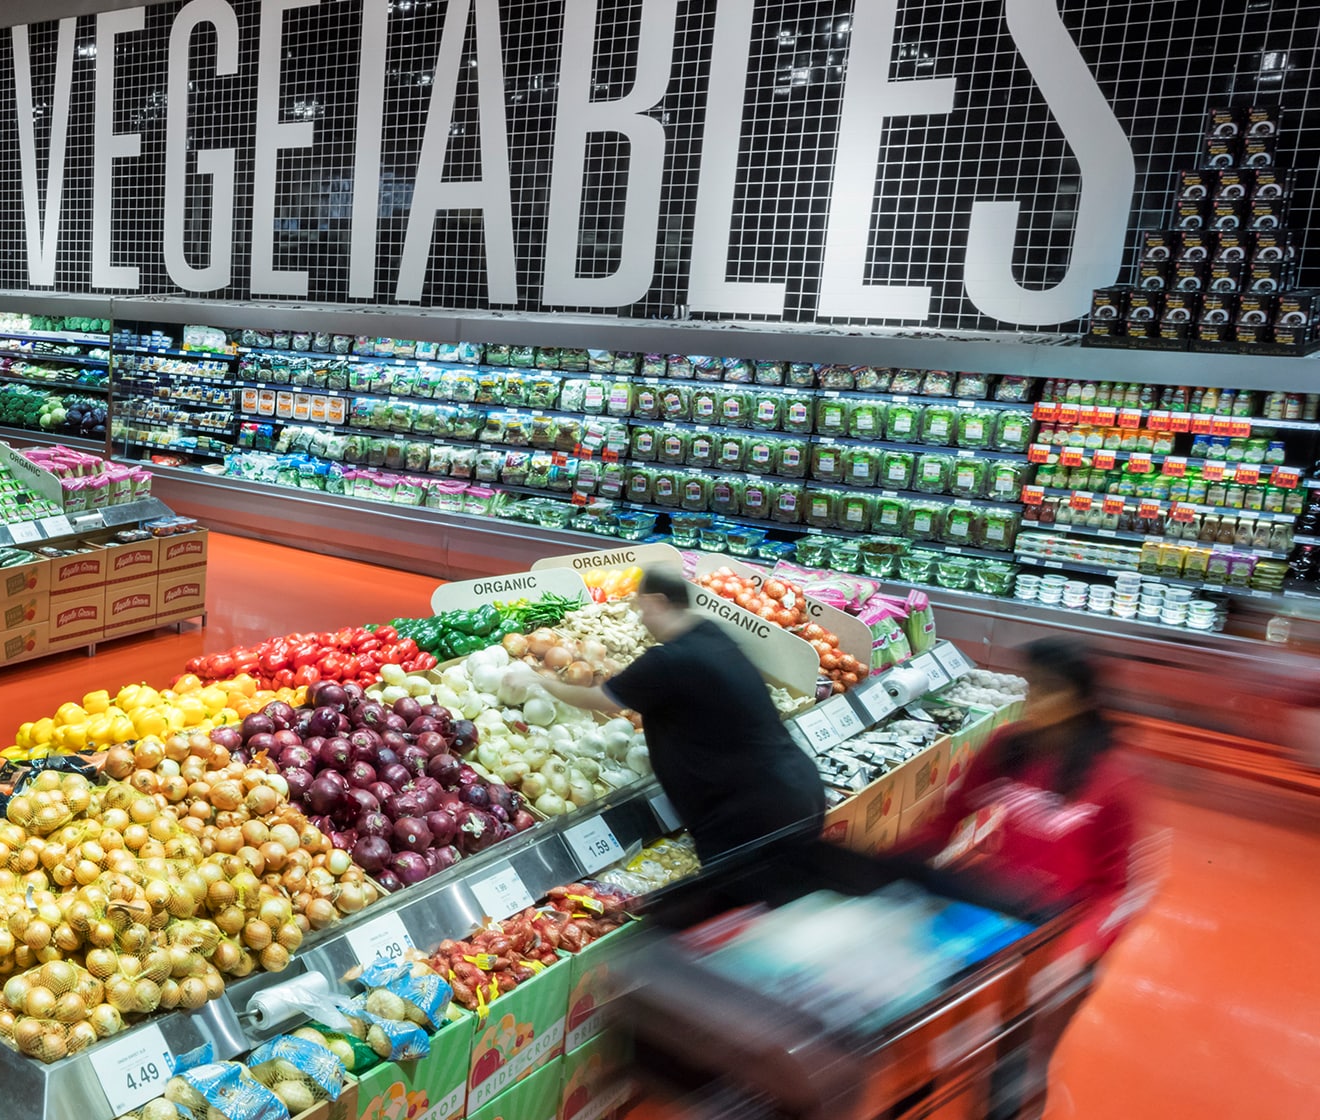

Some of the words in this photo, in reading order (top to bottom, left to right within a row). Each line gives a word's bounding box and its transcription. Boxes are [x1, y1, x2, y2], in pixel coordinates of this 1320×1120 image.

[12, 0, 1136, 326] VEGETABLES
[10, 452, 41, 477] ORGANIC
[168, 545, 185, 558] Apple
[185, 543, 201, 552] Grove
[115, 554, 134, 568] Apple
[134, 552, 151, 562] Grove
[573, 552, 636, 569] ORGANIC
[61, 564, 80, 578] Apple
[80, 562, 99, 572] Grove
[166, 587, 183, 601] Apple
[183, 585, 198, 595] Grove
[473, 576, 537, 596] ORGANIC
[114, 598, 131, 612] Apple
[132, 596, 149, 606] Grove
[59, 609, 78, 625] Apple
[78, 608, 96, 618] Grove
[695, 593, 771, 640] ORGANIC
[588, 840, 610, 858] 1.59
[477, 1063, 513, 1103] PRIDE
[526, 1027, 560, 1057] CROP
[126, 1062, 160, 1090] 4.49
